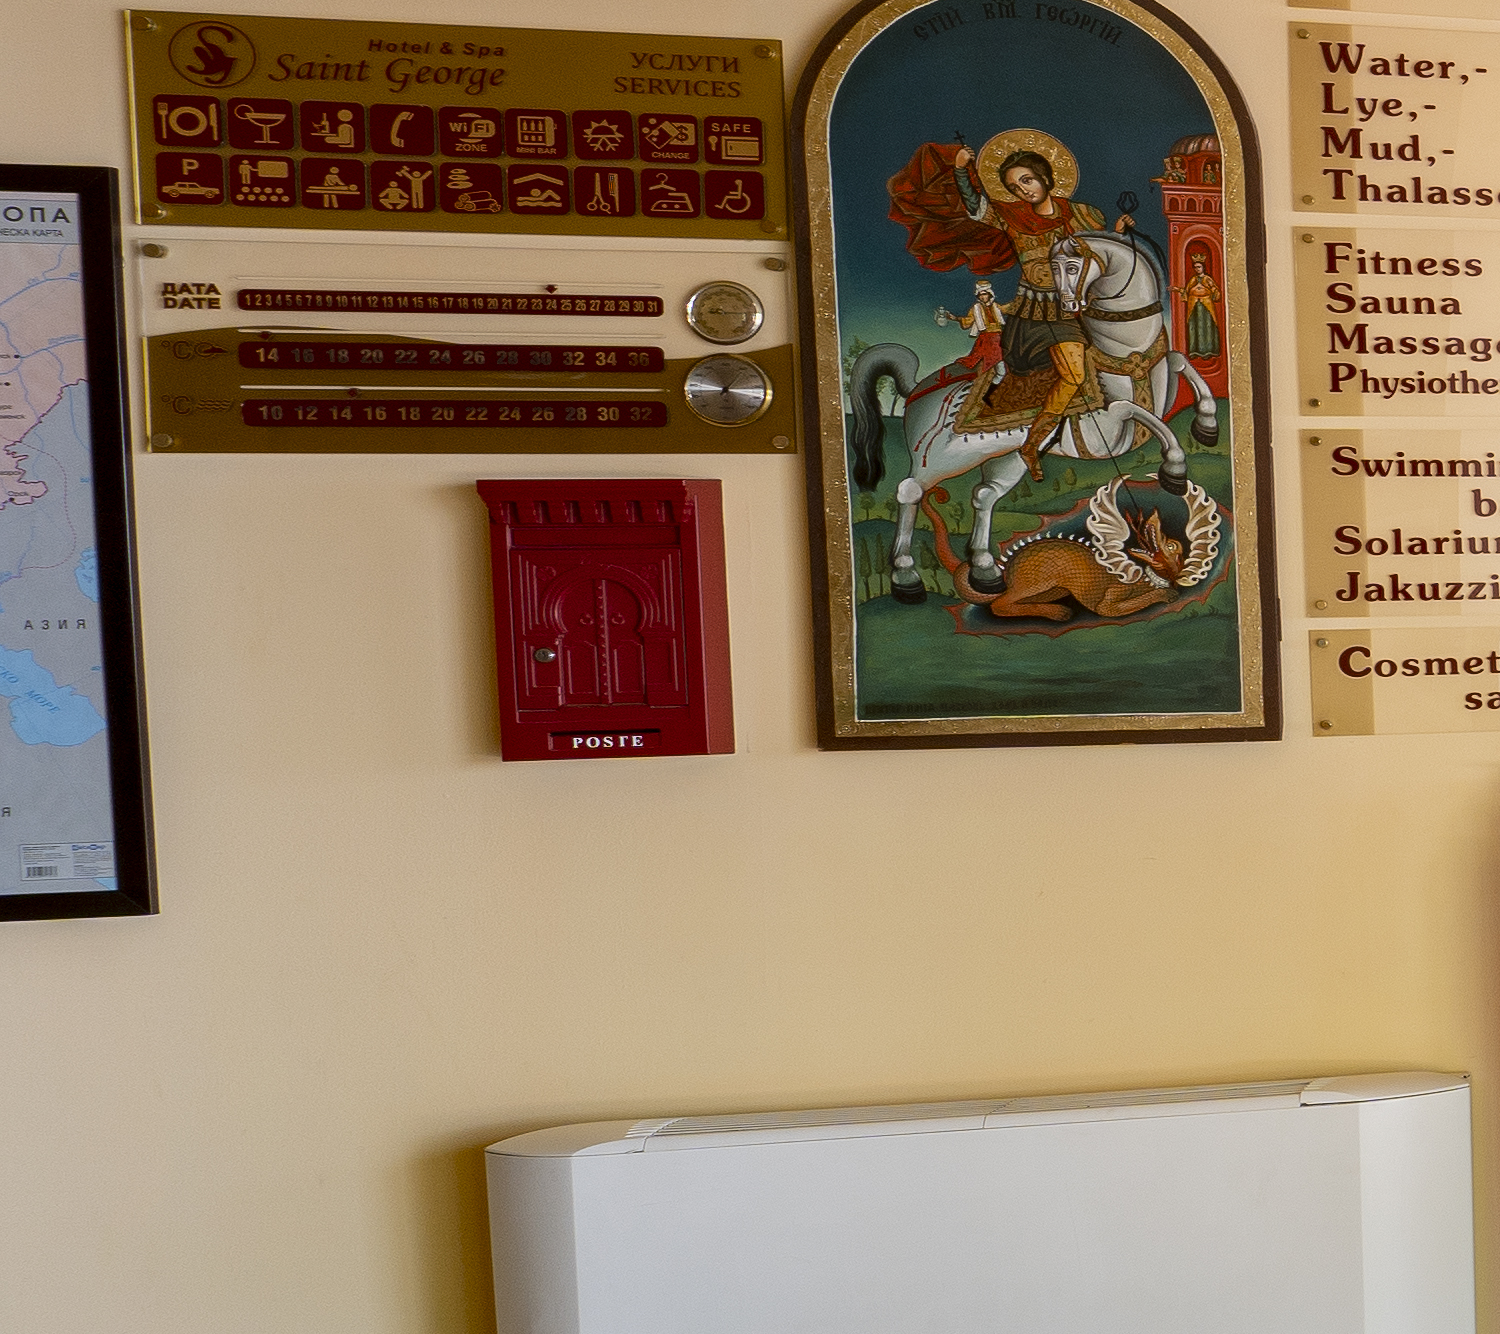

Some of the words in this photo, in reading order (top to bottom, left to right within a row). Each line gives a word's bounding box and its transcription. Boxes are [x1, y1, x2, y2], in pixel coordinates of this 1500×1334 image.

[368, 39, 430, 53] Hotel
[440, 42, 452, 54] &
[463, 44, 505, 58] Spa
[630, 52, 739, 73] УСЛУГИ
[1320, 42, 1488, 85] Water,-
[268, 54, 370, 81] Saint
[385, 57, 505, 95] George
[614, 76, 741, 98] SERVICES
[1321, 83, 1436, 122] Lye,-
[712, 123, 751, 133] SAFE
[455, 144, 488, 152] ZONE
[537, 147, 556, 155] BAR
[652, 151, 689, 160] CHANGE
[1321, 127, 1454, 167] Mud,-
[182, 158, 199, 175] P
[33, 229, 64, 237] КАРТА
[1324, 242, 1483, 277] Fitness
[163, 283, 221, 296] ДАТА
[164, 298, 221, 309] DATE
[245, 294, 250, 306] 1
[255, 294, 262, 306] 2
[266, 294, 272, 306] 3
[276, 294, 282, 306] 4
[286, 294, 292, 306] 5
[296, 295, 302, 306] 6
[306, 295, 312, 306] 7
[316, 295, 322, 307] 8
[326, 295, 333, 307] 9
[336, 295, 347, 307] 10
[352, 295, 362, 307] 11
[367, 295, 378, 307] 12
[383, 296, 394, 307] 13
[397, 296, 408, 308] 14
[412, 297, 424, 309] 15
[427, 297, 439, 309] 16
[442, 297, 453, 309] 17
[458, 297, 469, 309] 18
[473, 298, 484, 310] 19
[487, 298, 498, 310] 20
[502, 298, 513, 310] 21
[517, 298, 527, 310] 22
[531, 299, 542, 311] 23
[546, 299, 557, 311] 24
[561, 299, 572, 311] 25
[575, 299, 586, 311] 26
[590, 300, 600, 311] 27
[604, 300, 615, 312] 28
[619, 300, 630, 312] 29
[633, 300, 644, 312] 30
[648, 301, 658, 312] 31
[1326, 283, 1462, 315] Sauna
[256, 348, 279, 363] 14
[292, 348, 314, 363] 16
[327, 349, 349, 364] 18
[361, 349, 384, 364] 20
[395, 349, 418, 364] 22
[429, 350, 450, 364] 24
[463, 351, 485, 365] 26
[497, 351, 518, 365] 28
[530, 351, 551, 365] 30
[563, 352, 585, 366] 32
[596, 352, 617, 366] 34
[628, 352, 649, 366] 36
[259, 406, 283, 420] 10
[295, 406, 318, 420] 12
[330, 406, 352, 421] 14
[364, 406, 386, 421] 16
[398, 407, 421, 421] 18
[431, 407, 454, 421] 20
[466, 407, 488, 421] 22
[499, 407, 521, 421] 24
[532, 407, 554, 421] 26
[565, 407, 587, 421] 28
[598, 407, 619, 421] 30
[630, 408, 652, 421] 32
[24, 619, 87, 630] АЗИЯ
[25, 690, 61, 714] МОРЕ
[572, 735, 643, 749] POSTE
